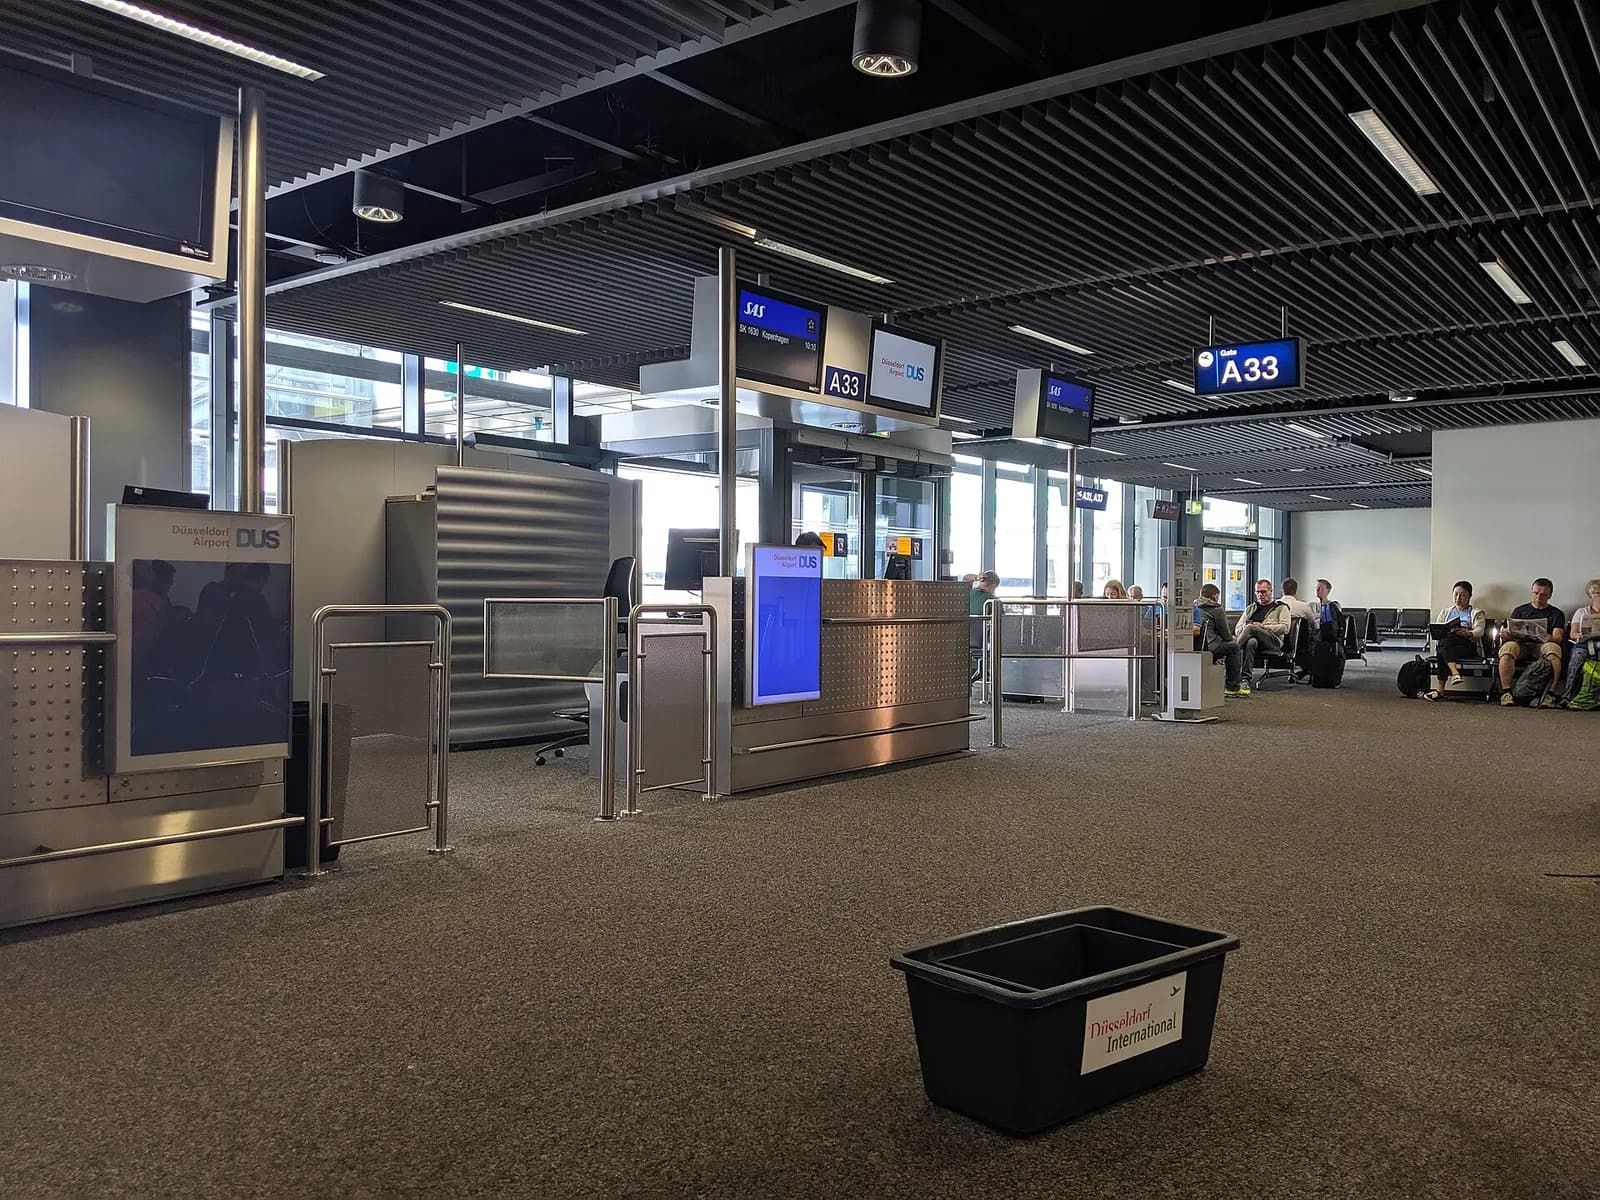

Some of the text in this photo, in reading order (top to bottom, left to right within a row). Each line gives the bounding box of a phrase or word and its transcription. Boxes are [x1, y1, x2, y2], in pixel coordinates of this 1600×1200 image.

[743, 301, 766, 319] SAS
[739, 324, 748, 334] SK
[761, 330, 790, 345] Kopenhagen
[1220, 348, 1238, 357] Gate
[889, 367, 905, 379] Airport
[906, 364, 925, 382] DUS
[1222, 355, 1279, 384] A33
[829, 371, 859, 397] A33
[1049, 385, 1062, 397] SAS
[172, 524, 230, 537] Düsseldorf
[236, 528, 280, 549] DUS
[192, 537, 230, 549] Airport
[799, 556, 817, 569] DUS
[1090, 1003, 1153, 1039] Düsseldorf
[1106, 1012, 1177, 1053] International
